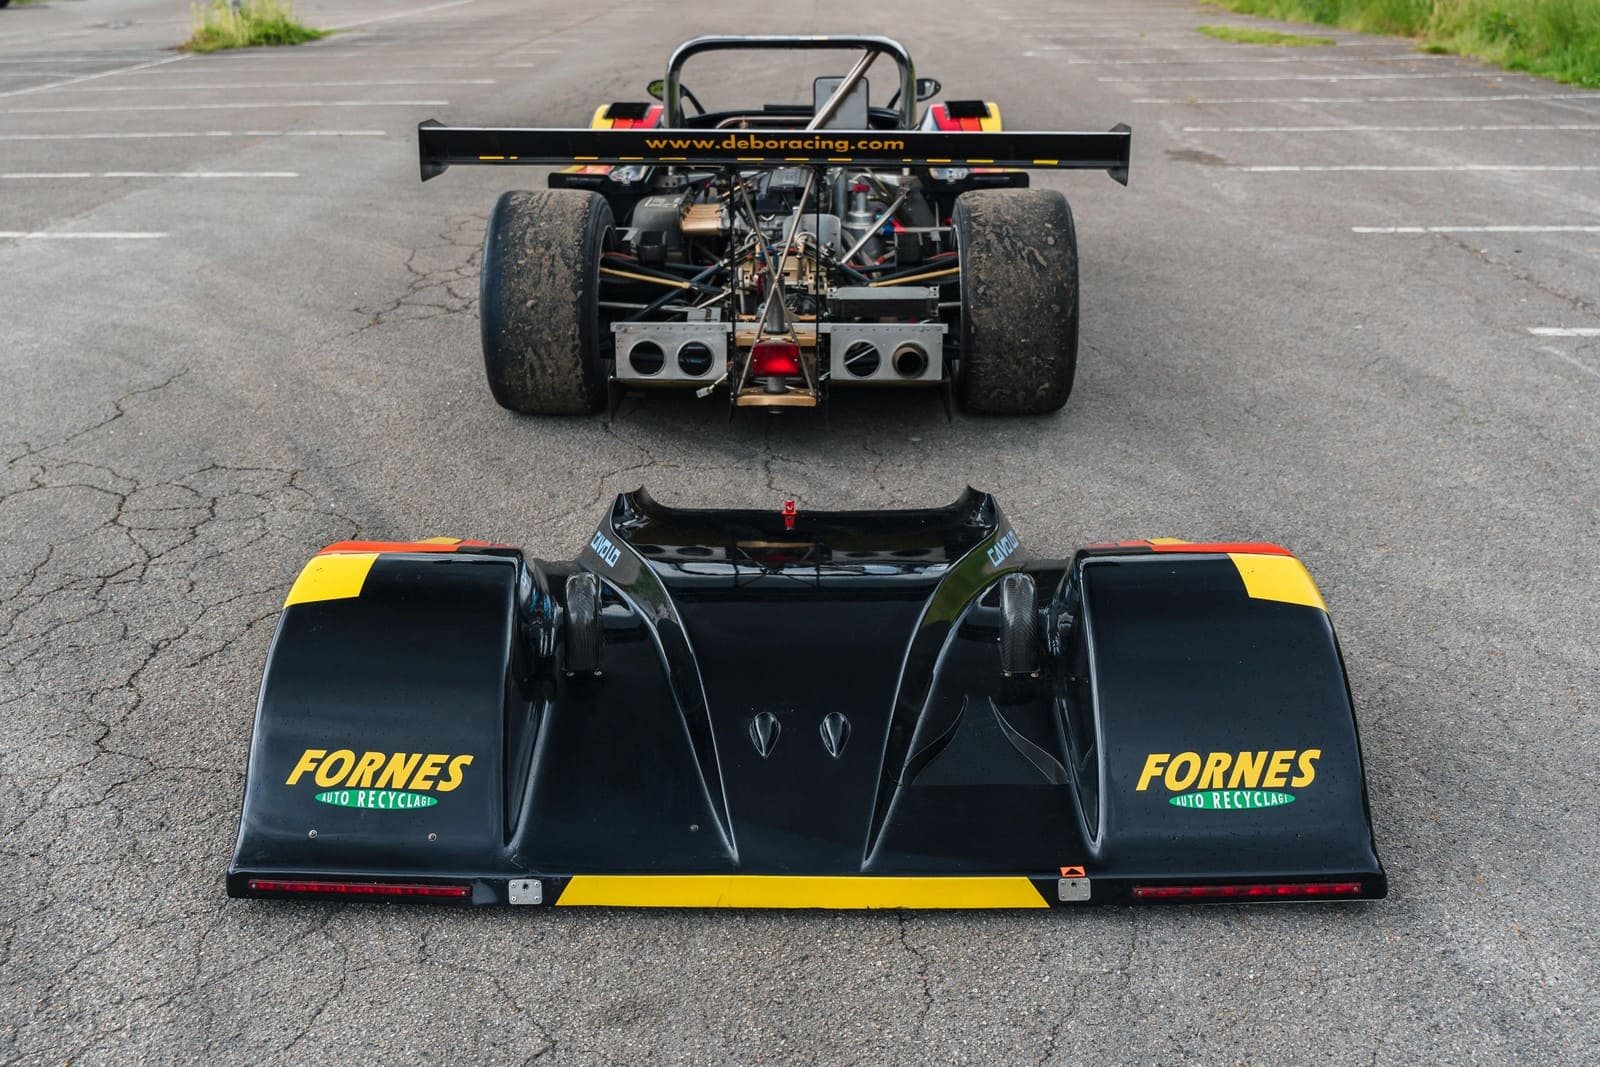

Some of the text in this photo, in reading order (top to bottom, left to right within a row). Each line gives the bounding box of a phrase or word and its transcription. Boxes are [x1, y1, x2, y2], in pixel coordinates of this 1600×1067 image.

[645, 134, 905, 153] www.deboracing.com
[285, 748, 475, 792] FORNES
[1135, 748, 1322, 792] FORNES
[322, 791, 432, 809] AUTO RECYCLAGE
[1176, 791, 1289, 809] AUTO RECYCLAGE
